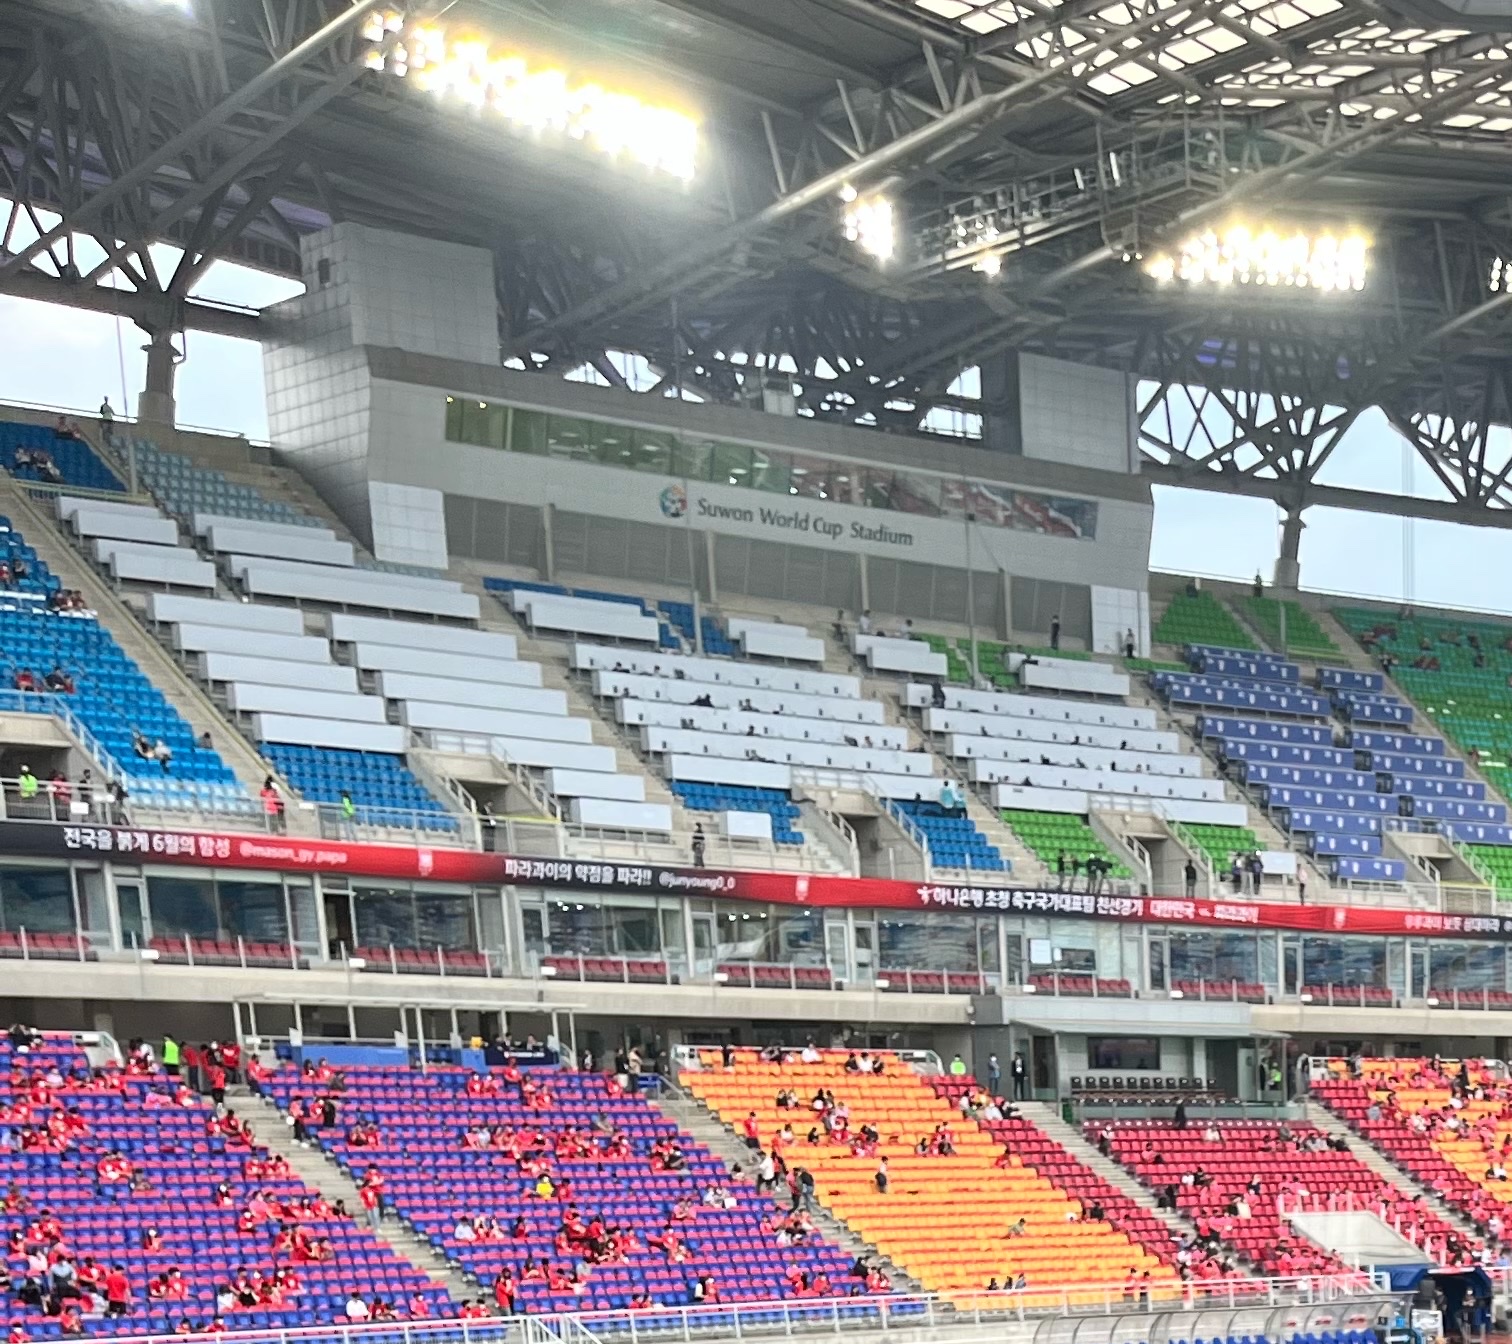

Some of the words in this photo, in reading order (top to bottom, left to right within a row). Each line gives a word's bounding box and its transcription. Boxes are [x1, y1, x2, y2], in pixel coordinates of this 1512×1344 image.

[697, 498, 753, 523] Suwon
[759, 507, 809, 531] World
[812, 517, 843, 540] Cup
[849, 522, 914, 546] Stadium
[505, 859, 572, 881] 파라과이의
[933, 887, 984, 909] 하나은행
